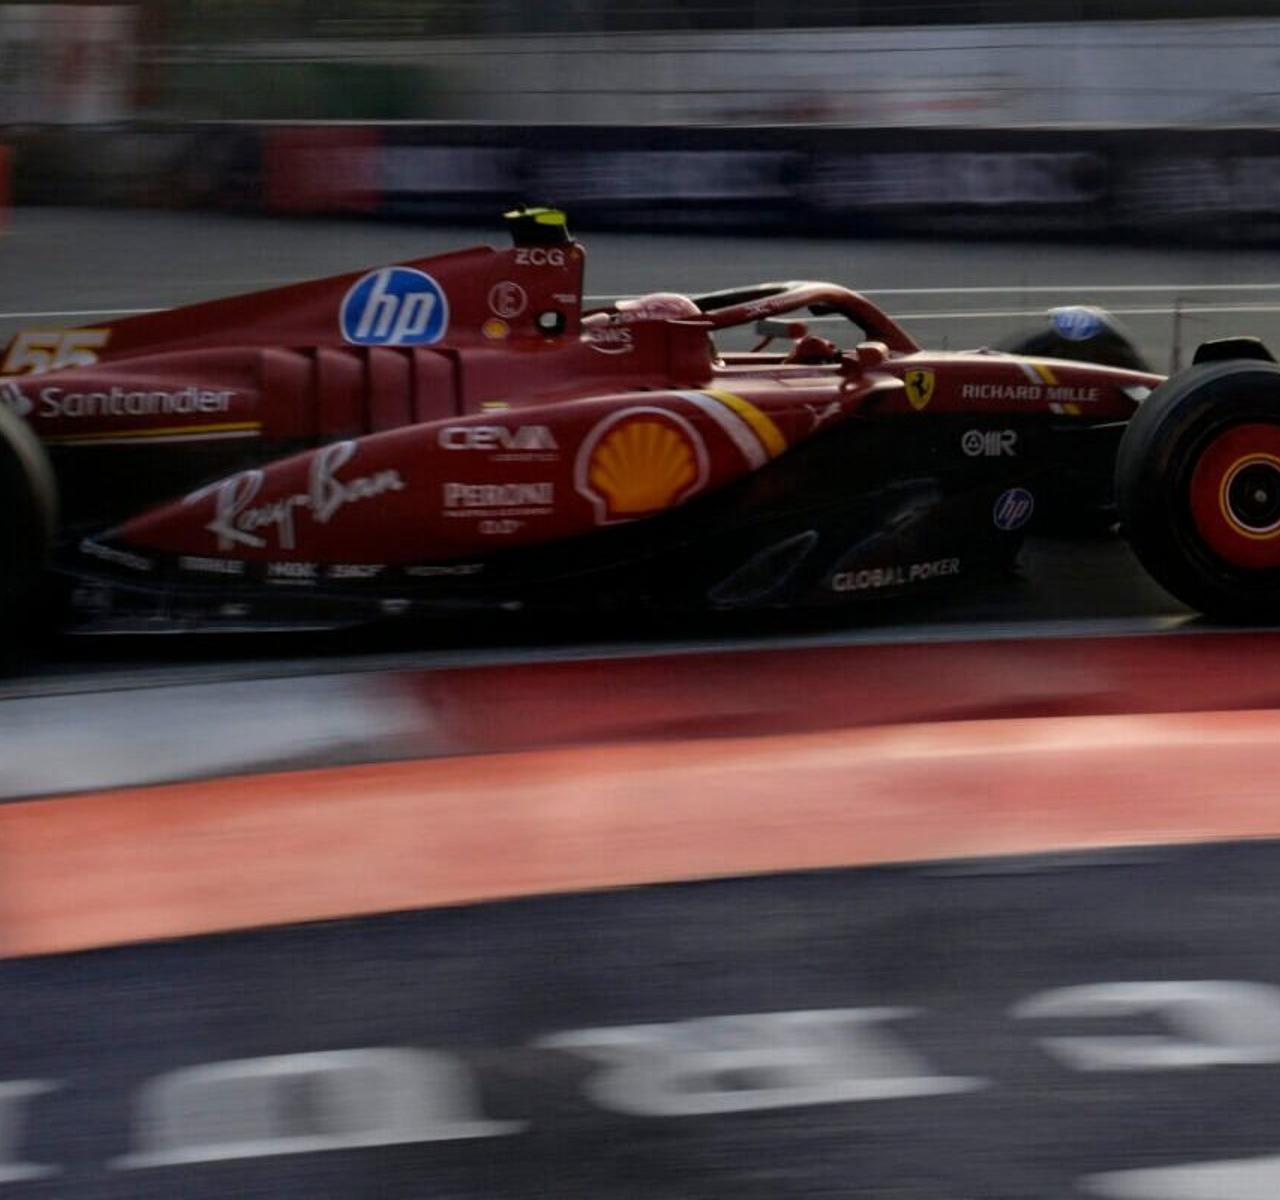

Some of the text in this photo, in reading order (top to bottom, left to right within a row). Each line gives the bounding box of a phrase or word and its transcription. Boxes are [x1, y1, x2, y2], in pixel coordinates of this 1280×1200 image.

[515, 248, 565, 267] ZCG
[360, 267, 435, 345] hp
[1, 328, 111, 376] 55
[39, 386, 238, 418] Santander
[961, 384, 1100, 401] RICHARD MILLE
[436, 425, 560, 450] CEVA
[184, 440, 407, 550] Ray-Ban
[443, 482, 555, 507] PERONI
[996, 488, 1031, 530] hp
[831, 558, 962, 592] GLOBAL POKER
